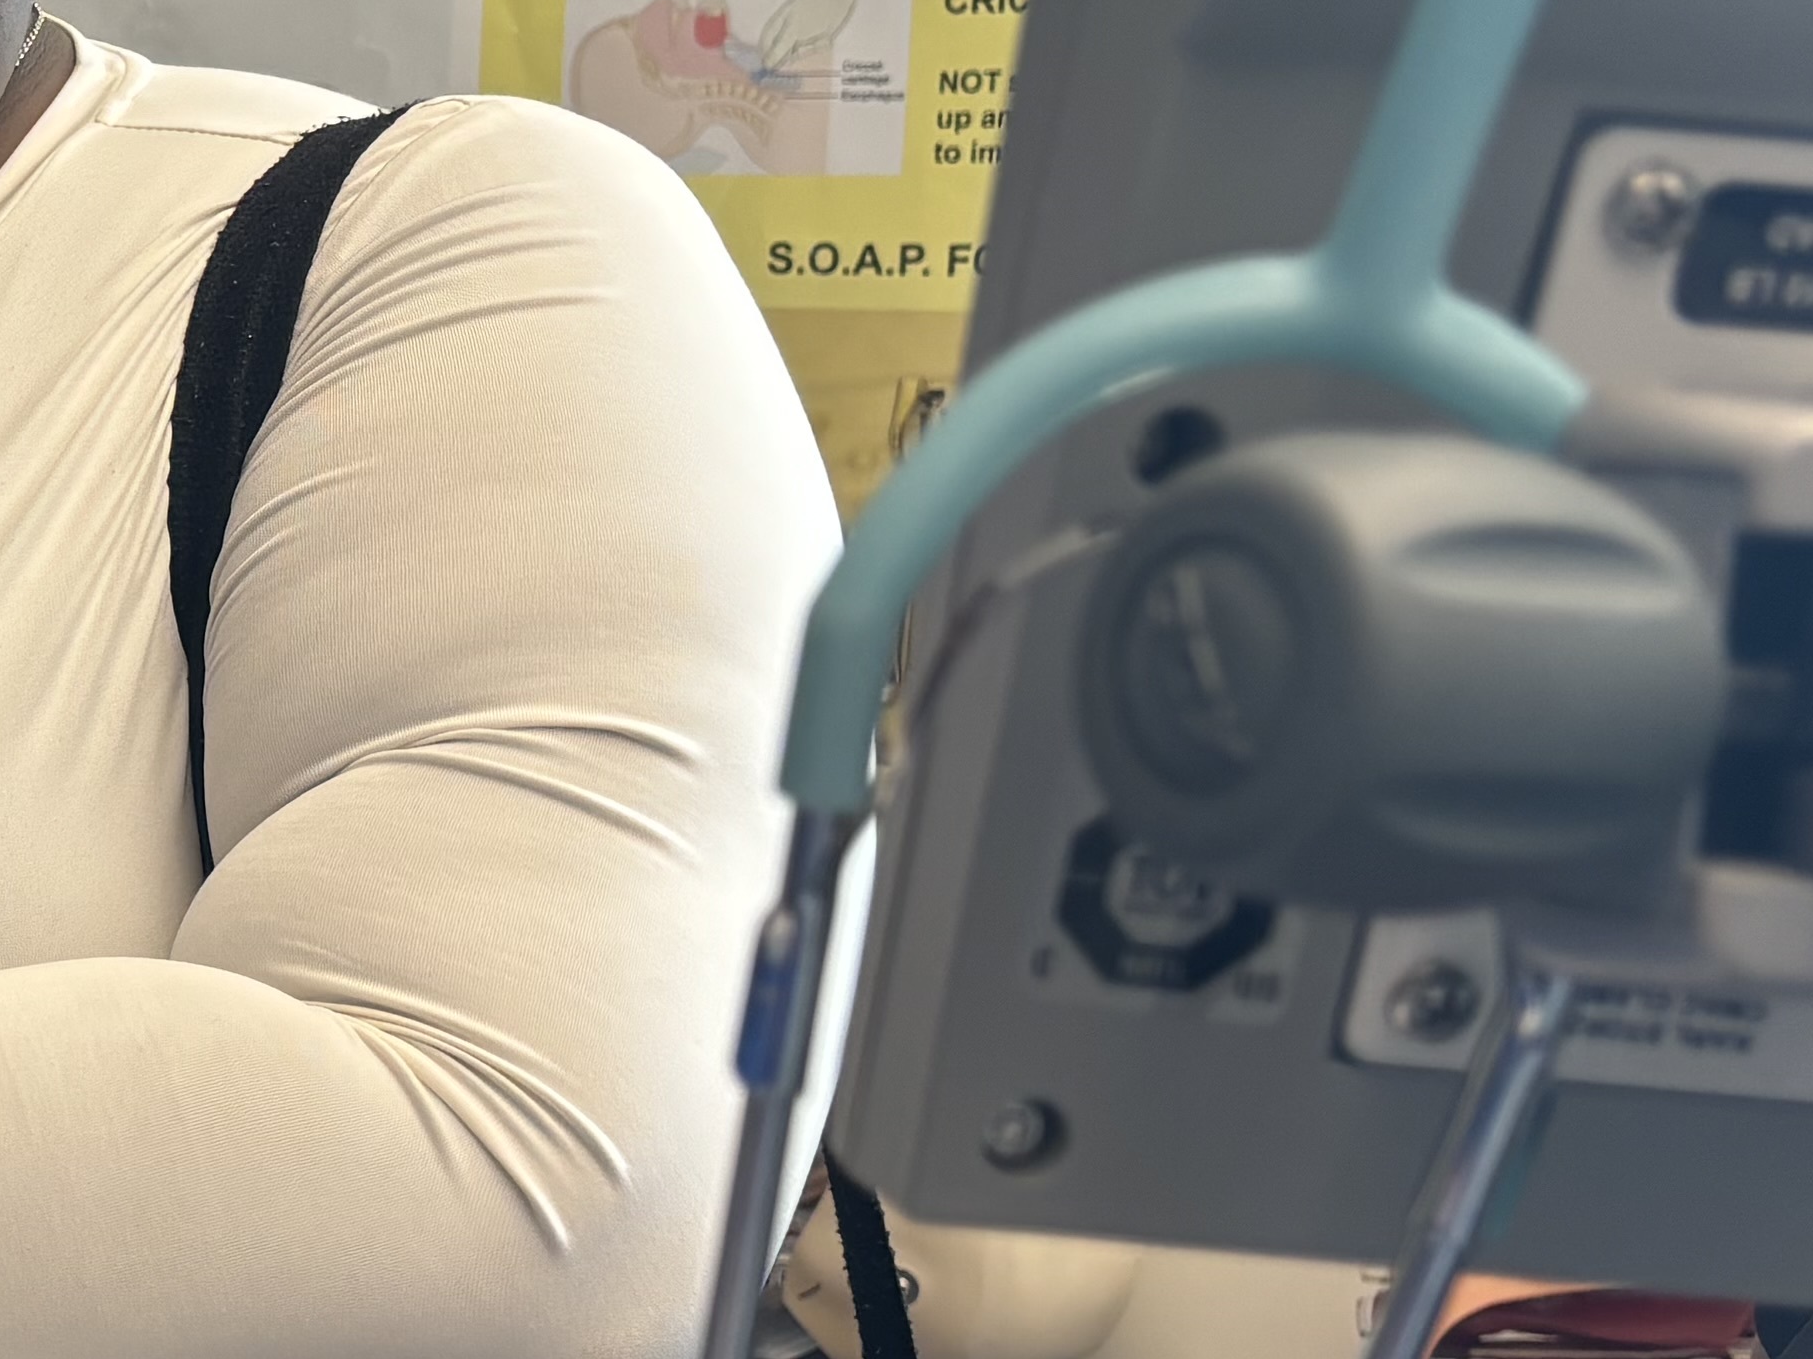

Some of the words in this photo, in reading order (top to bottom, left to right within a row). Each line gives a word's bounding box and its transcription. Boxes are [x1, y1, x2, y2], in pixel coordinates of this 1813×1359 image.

[939, 68, 1002, 95] NOT
[937, 109, 972, 135] up
[934, 140, 961, 164] to
[767, 241, 930, 277] S.O.A.P.
